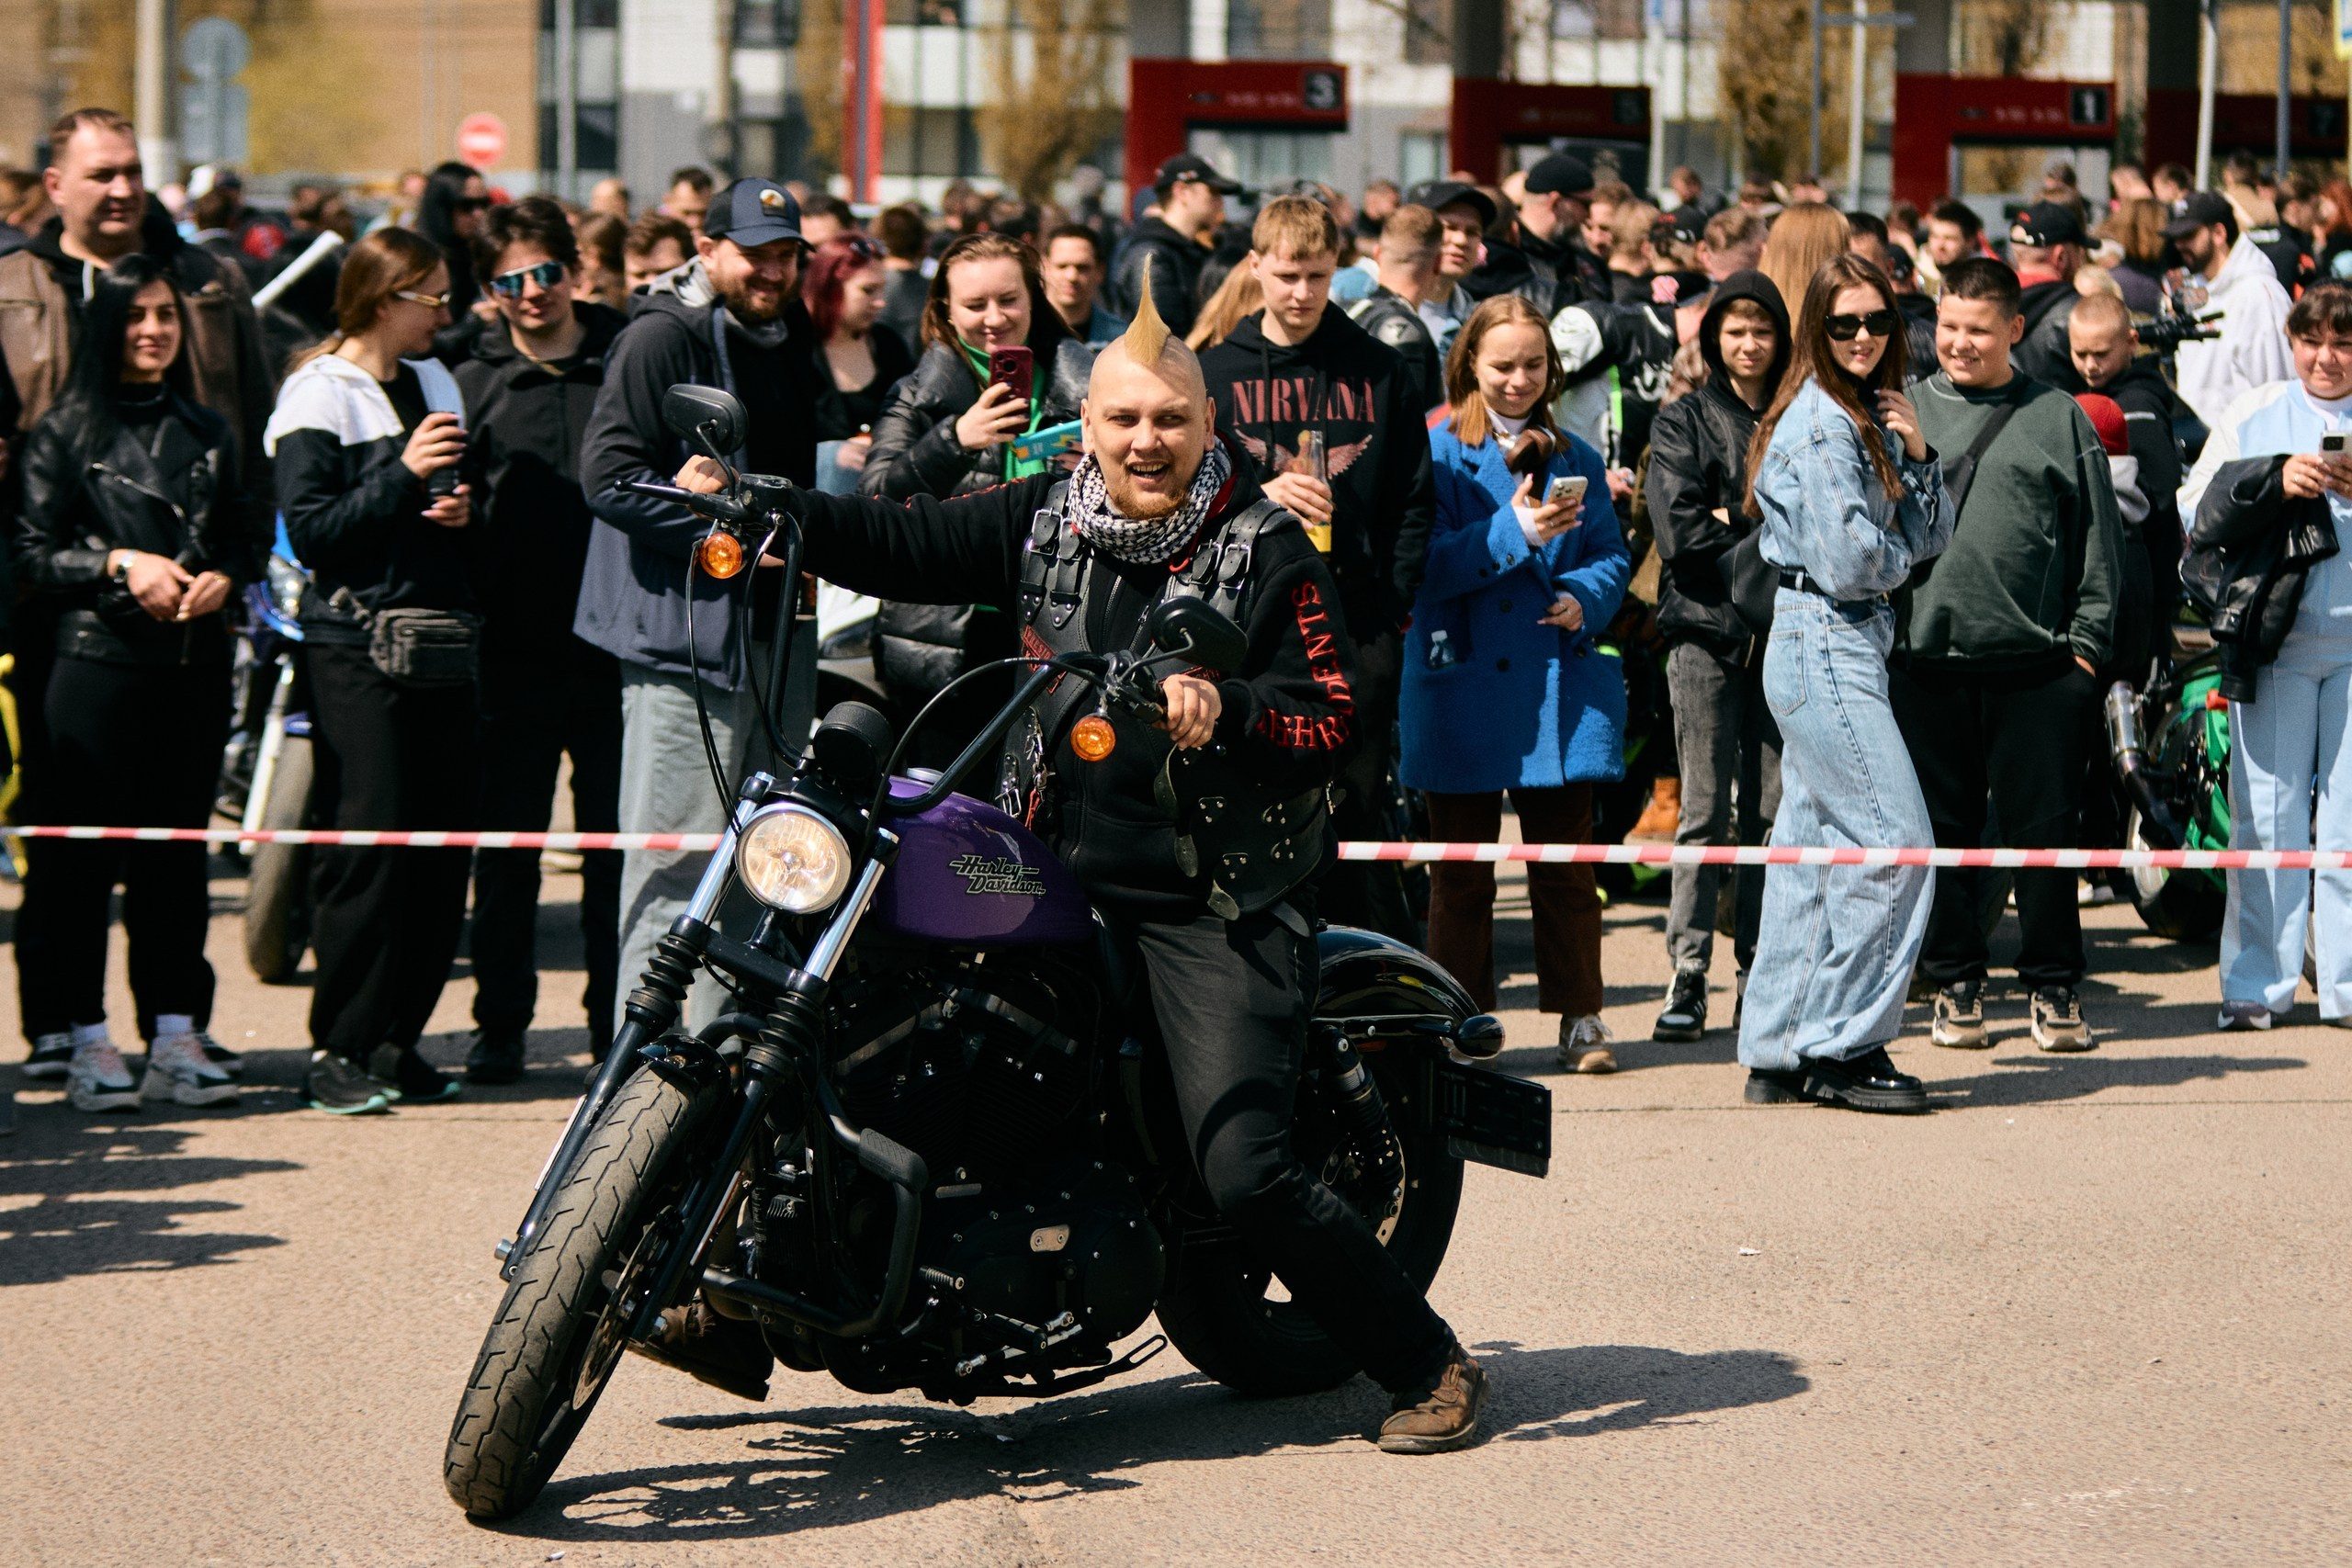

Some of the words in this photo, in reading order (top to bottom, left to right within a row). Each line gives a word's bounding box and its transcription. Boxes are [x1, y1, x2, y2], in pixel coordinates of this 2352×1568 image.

[1309, 73, 1335, 107] 3
[2082, 89, 2096, 123] 1
[967, 874, 1046, 895] Davidson
